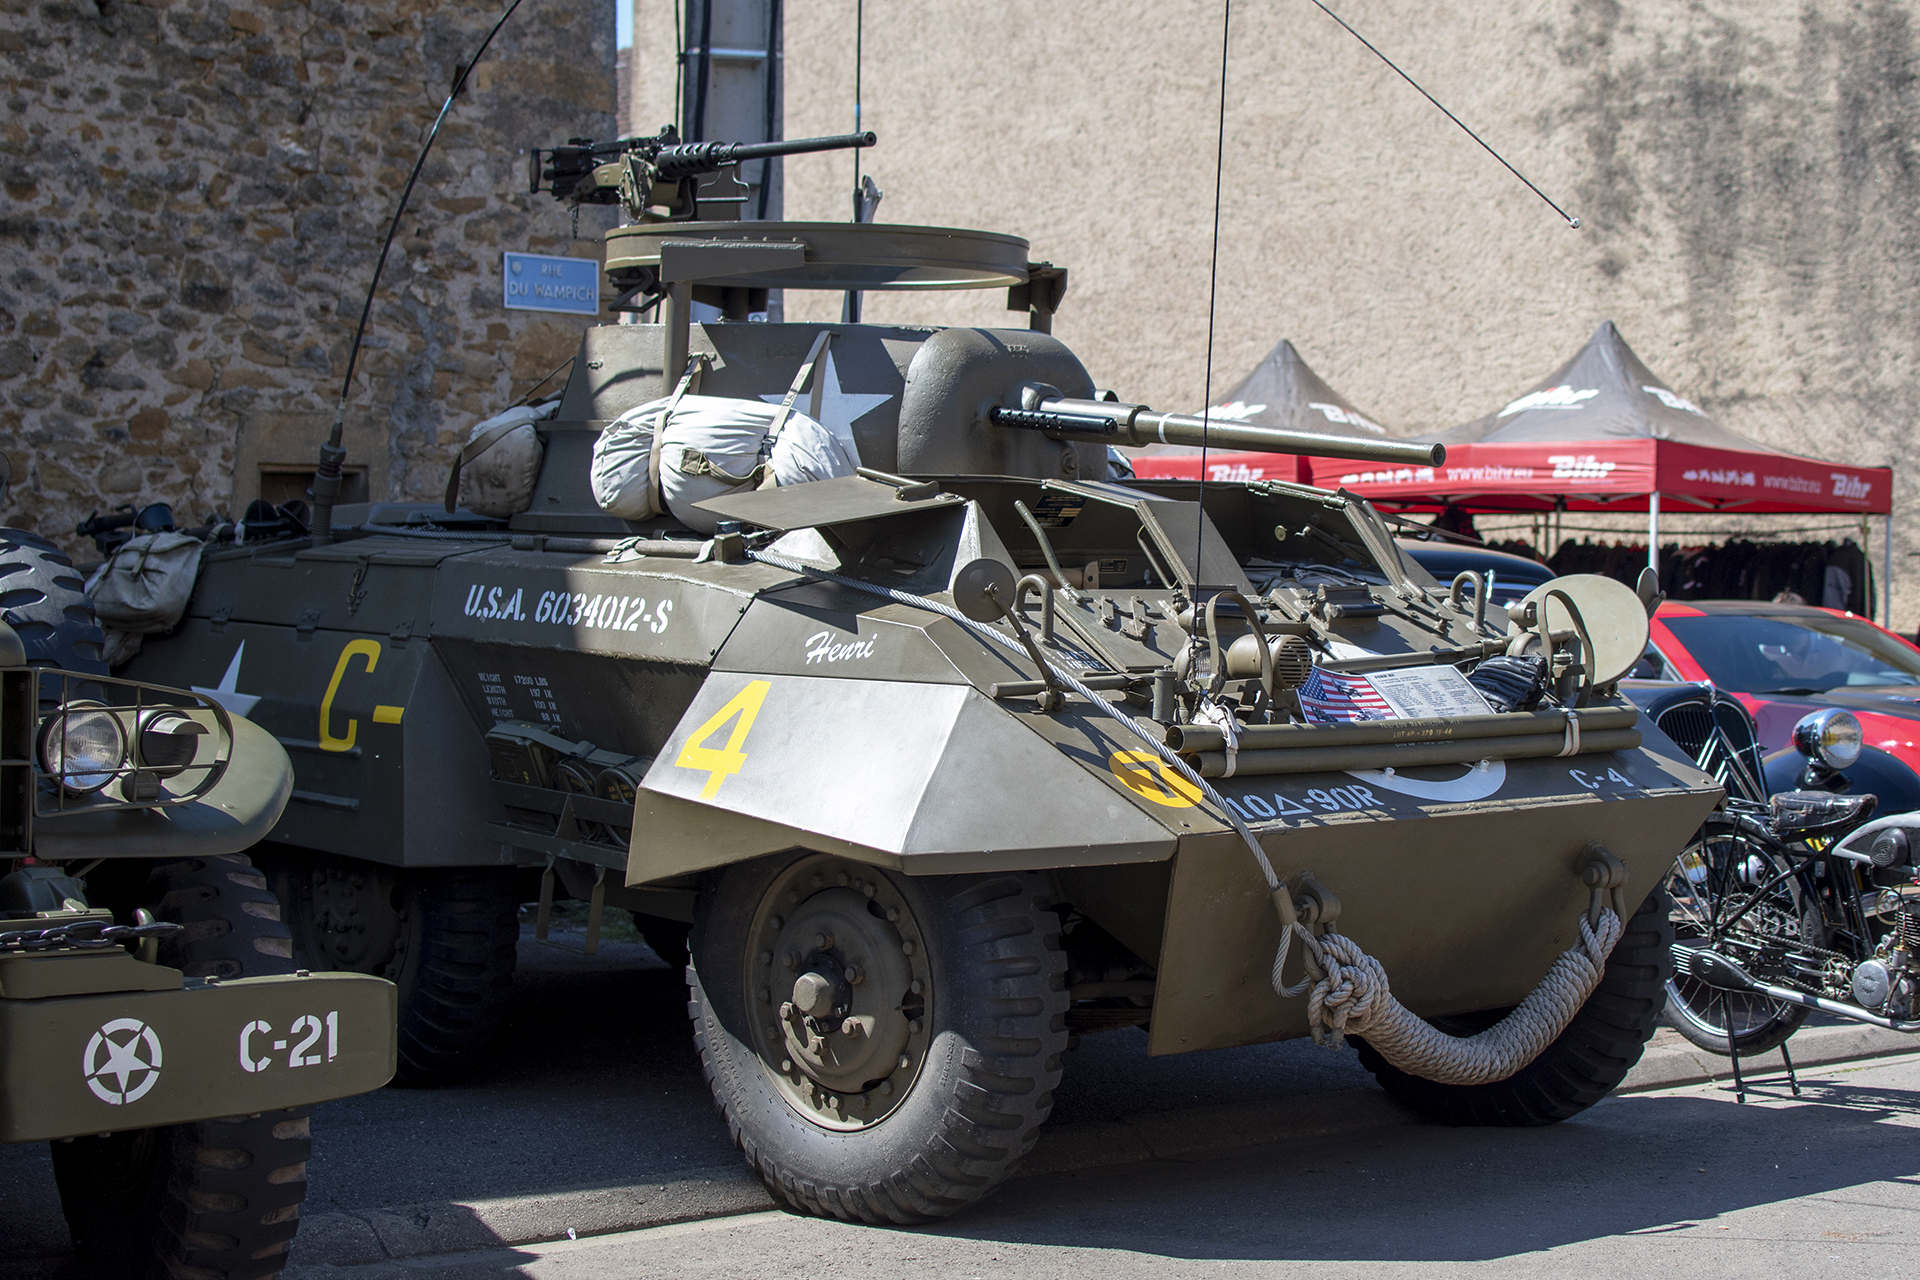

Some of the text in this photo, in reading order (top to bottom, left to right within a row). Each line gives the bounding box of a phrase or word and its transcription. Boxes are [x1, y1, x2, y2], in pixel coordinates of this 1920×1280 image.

[541, 263, 563, 277] RUE
[509, 281, 595, 301] DU WAMPICH
[1446, 464, 1534, 482] www.bihr.eu
[1830, 472, 1872, 498] Bihr
[464, 584, 673, 634] U.S.A. 6034012-S
[804, 630, 878, 665] Henri
[674, 680, 772, 801] 4
[1569, 767, 1635, 790] C-4
[240, 1010, 338, 1073] C-21
